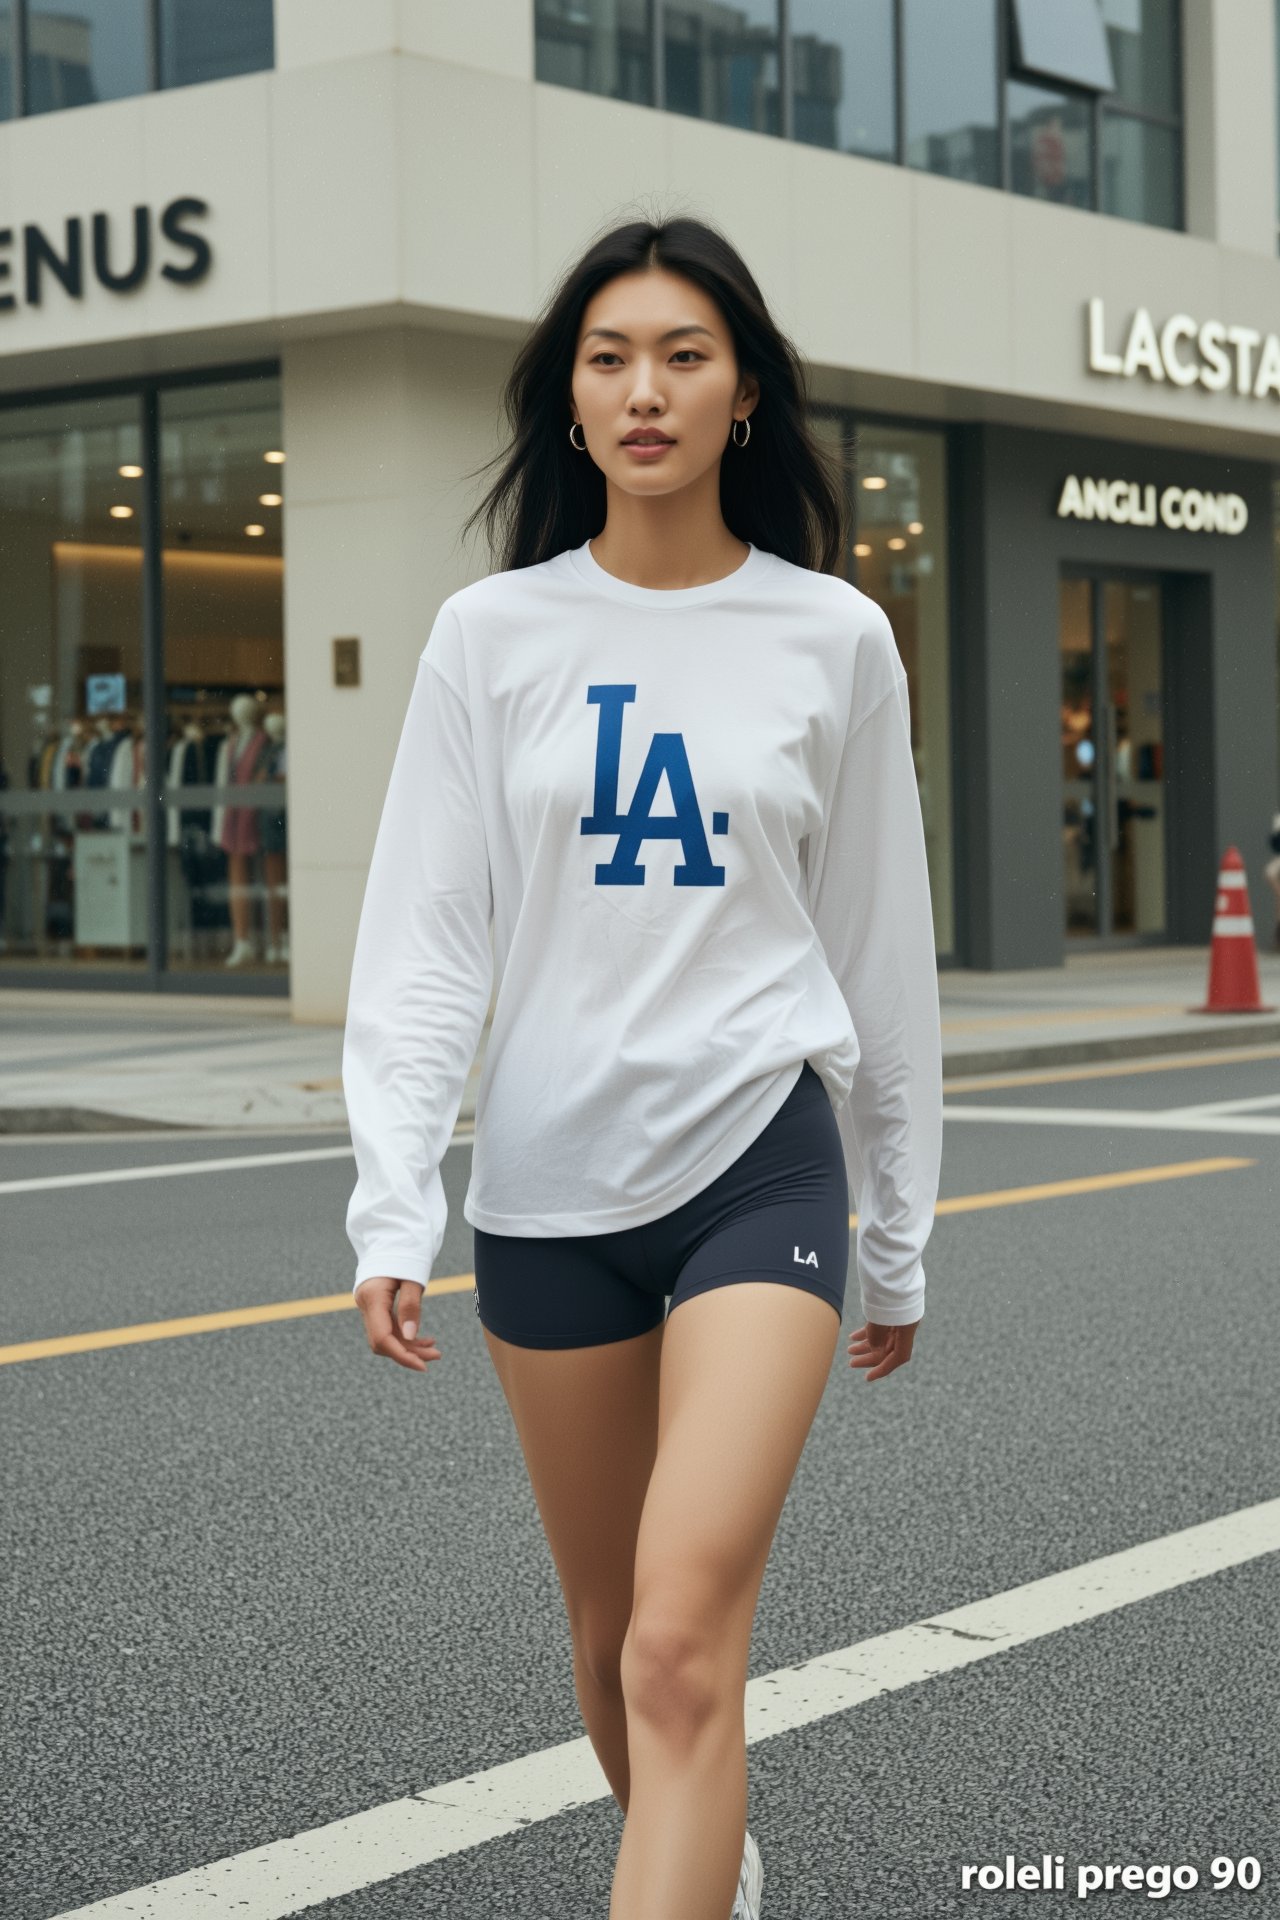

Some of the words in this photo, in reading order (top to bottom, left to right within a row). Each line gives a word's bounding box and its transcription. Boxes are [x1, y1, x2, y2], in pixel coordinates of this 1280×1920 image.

[1160, 486, 1249, 535] COND
[580, 684, 729, 887] LA
[793, 1245, 819, 1269] LA
